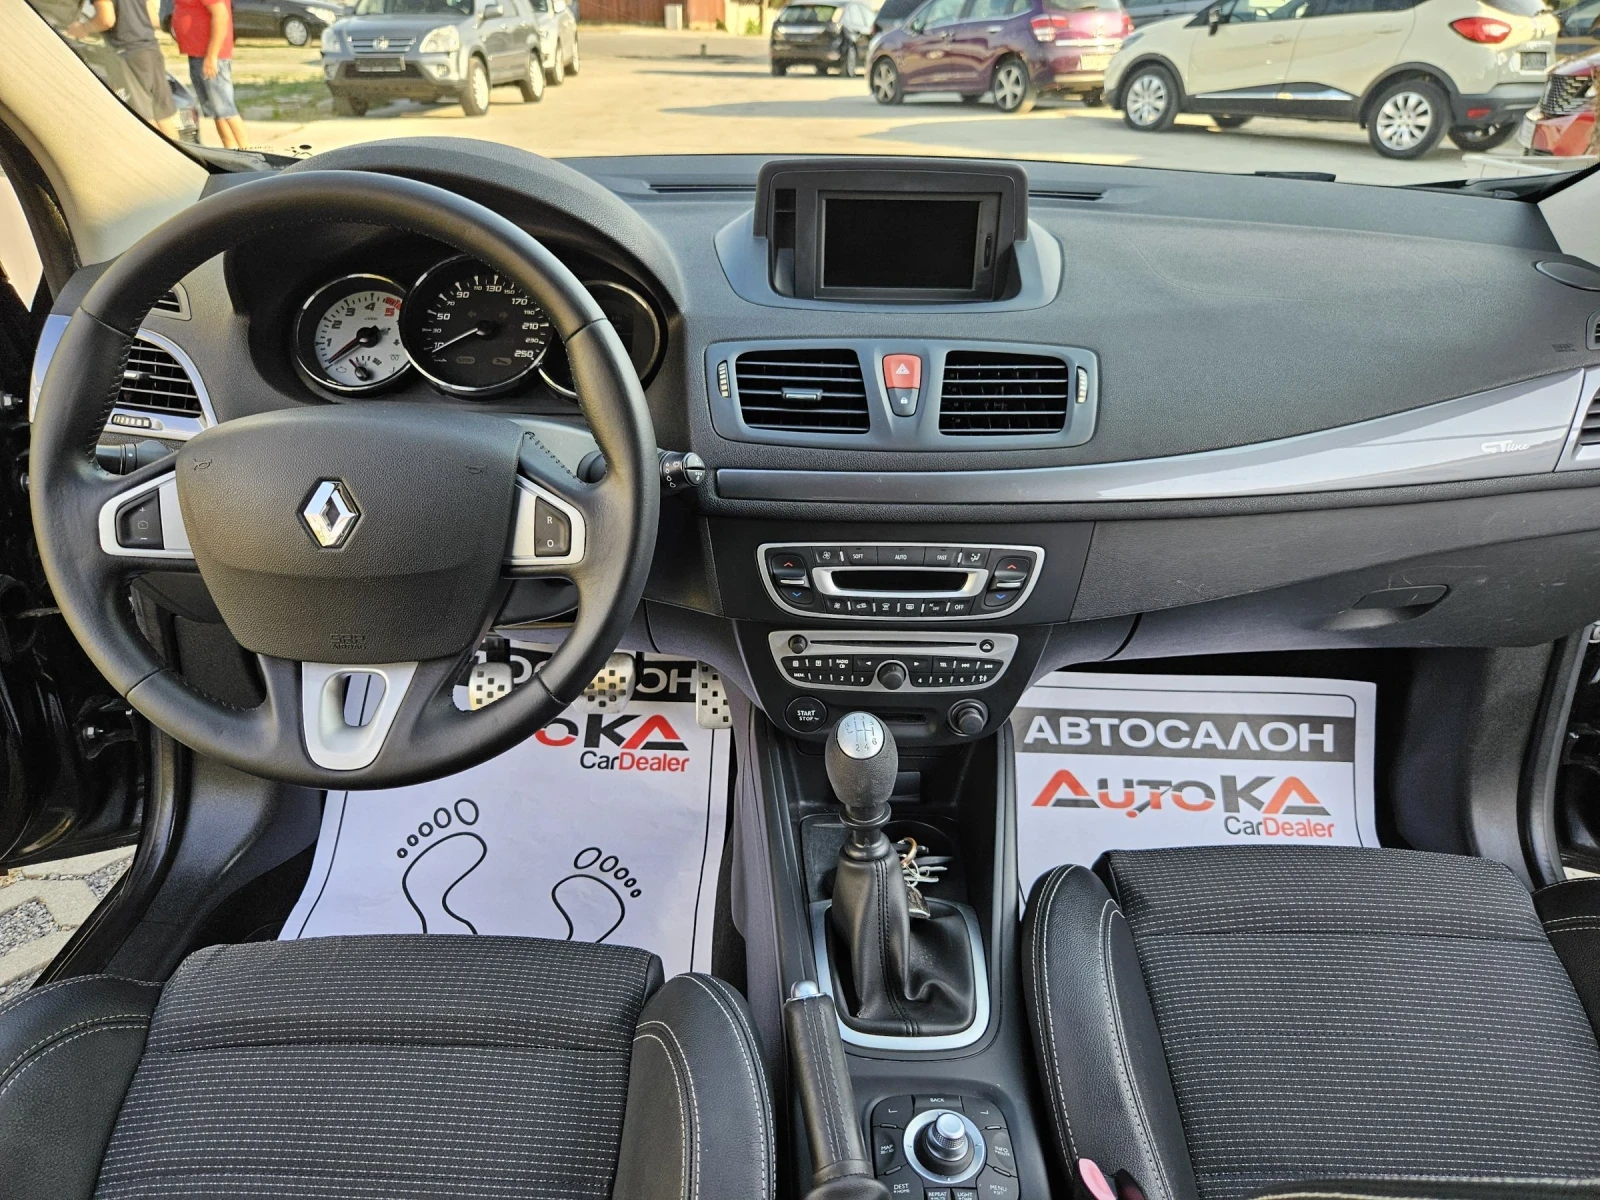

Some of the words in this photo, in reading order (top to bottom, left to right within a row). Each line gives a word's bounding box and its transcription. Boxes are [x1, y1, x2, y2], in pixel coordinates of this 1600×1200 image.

[486, 285, 502, 293] 130
[456, 291, 470, 299] 90
[365, 302, 376, 311] 4
[511, 298, 528, 306] 170
[345, 307, 356, 317] 3
[384, 307, 395, 317] 5
[436, 313, 451, 321] 50
[332, 320, 342, 329] 2
[326, 338, 333, 347] 1
[514, 350, 534, 358] 250
[547, 516, 553, 525] R
[1024, 715, 1335, 753] АВТОСАЛОН
[855, 743, 860, 752] 2
[580, 750, 690, 772] CarDealer
[1224, 816, 1335, 838] CarDealer
[990, 1184, 1008, 1192] MENU
